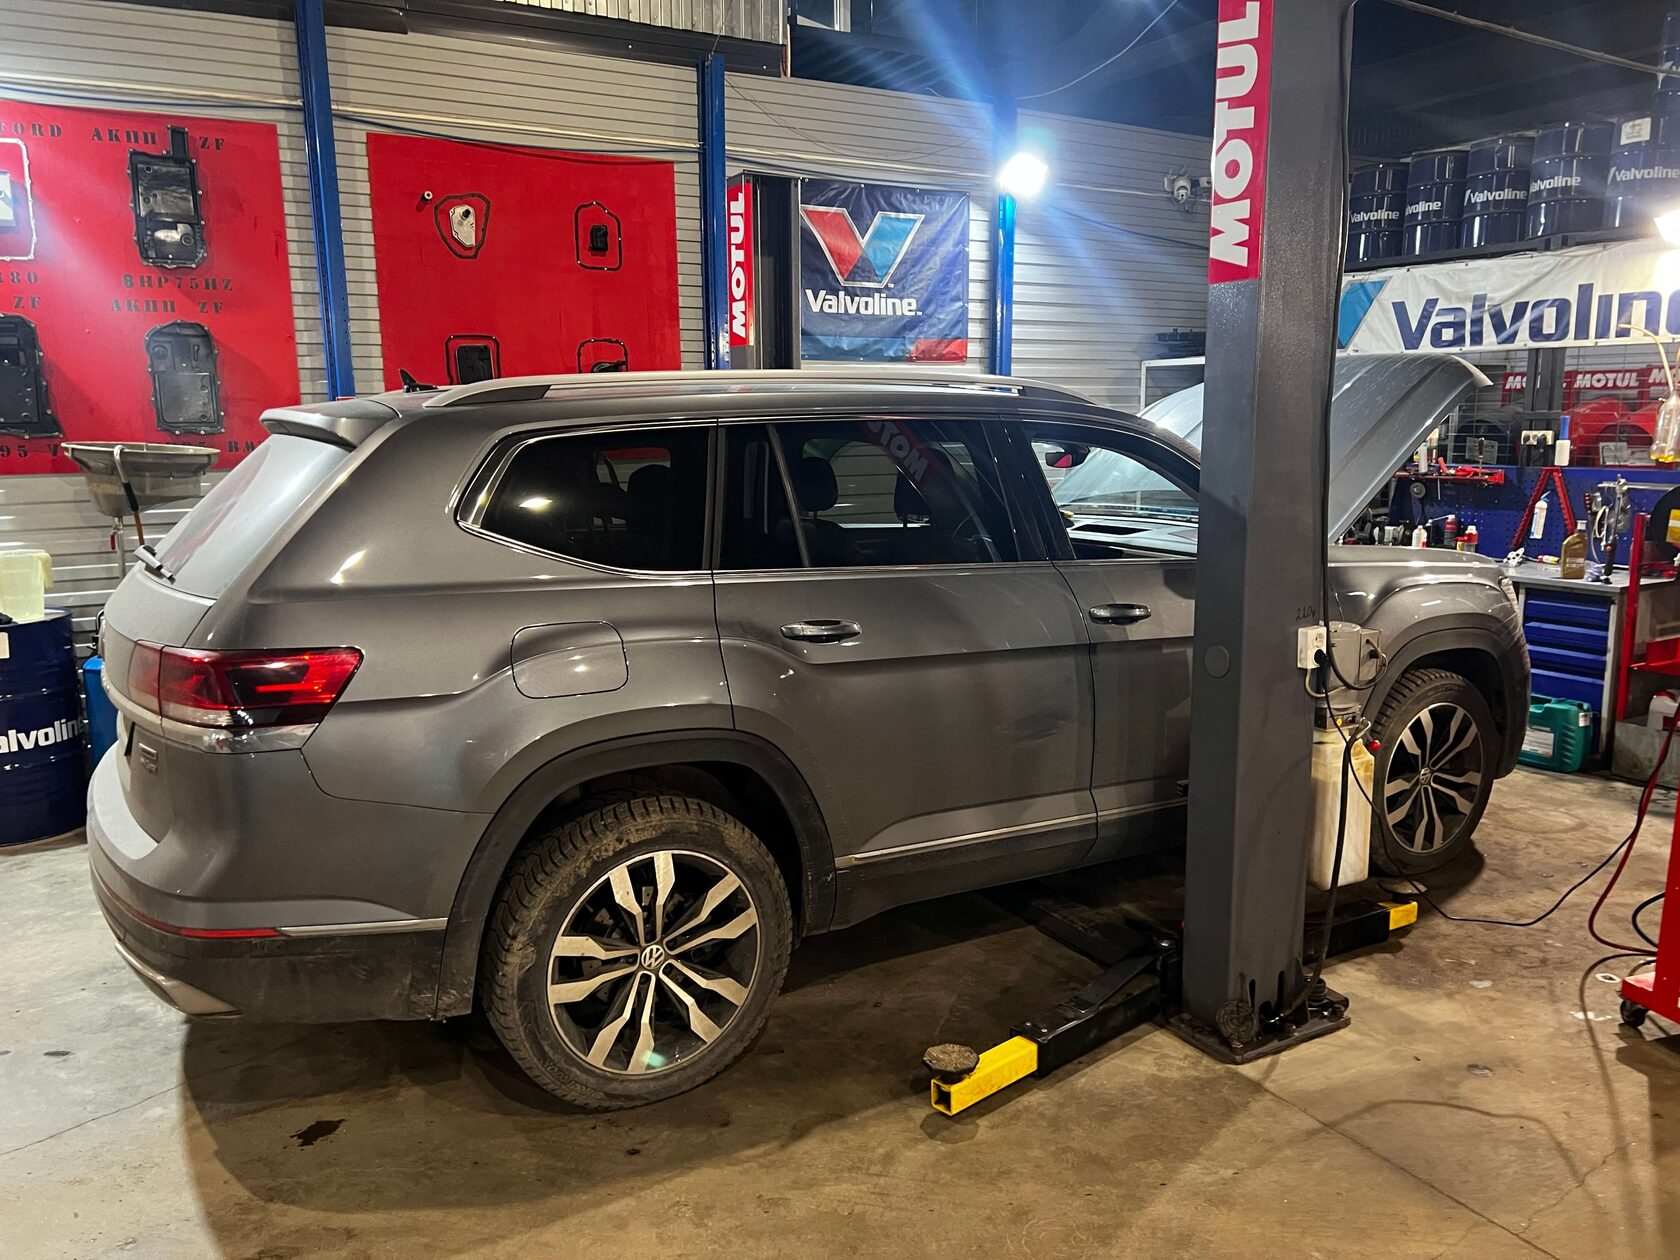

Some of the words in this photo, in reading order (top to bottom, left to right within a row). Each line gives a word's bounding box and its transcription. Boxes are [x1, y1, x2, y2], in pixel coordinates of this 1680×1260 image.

[1209, 1, 1260, 268] MOTUL
[199, 136, 225, 150] ZF
[1470, 187, 1528, 204] Valvoline
[1350, 209, 1400, 224] Valvoline
[730, 191, 747, 339] MOTUL
[13, 296, 41, 309] ZF
[198, 301, 223, 314] ZF
[804, 289, 917, 316] Valvoline
[1573, 372, 1639, 388] MOTUL
